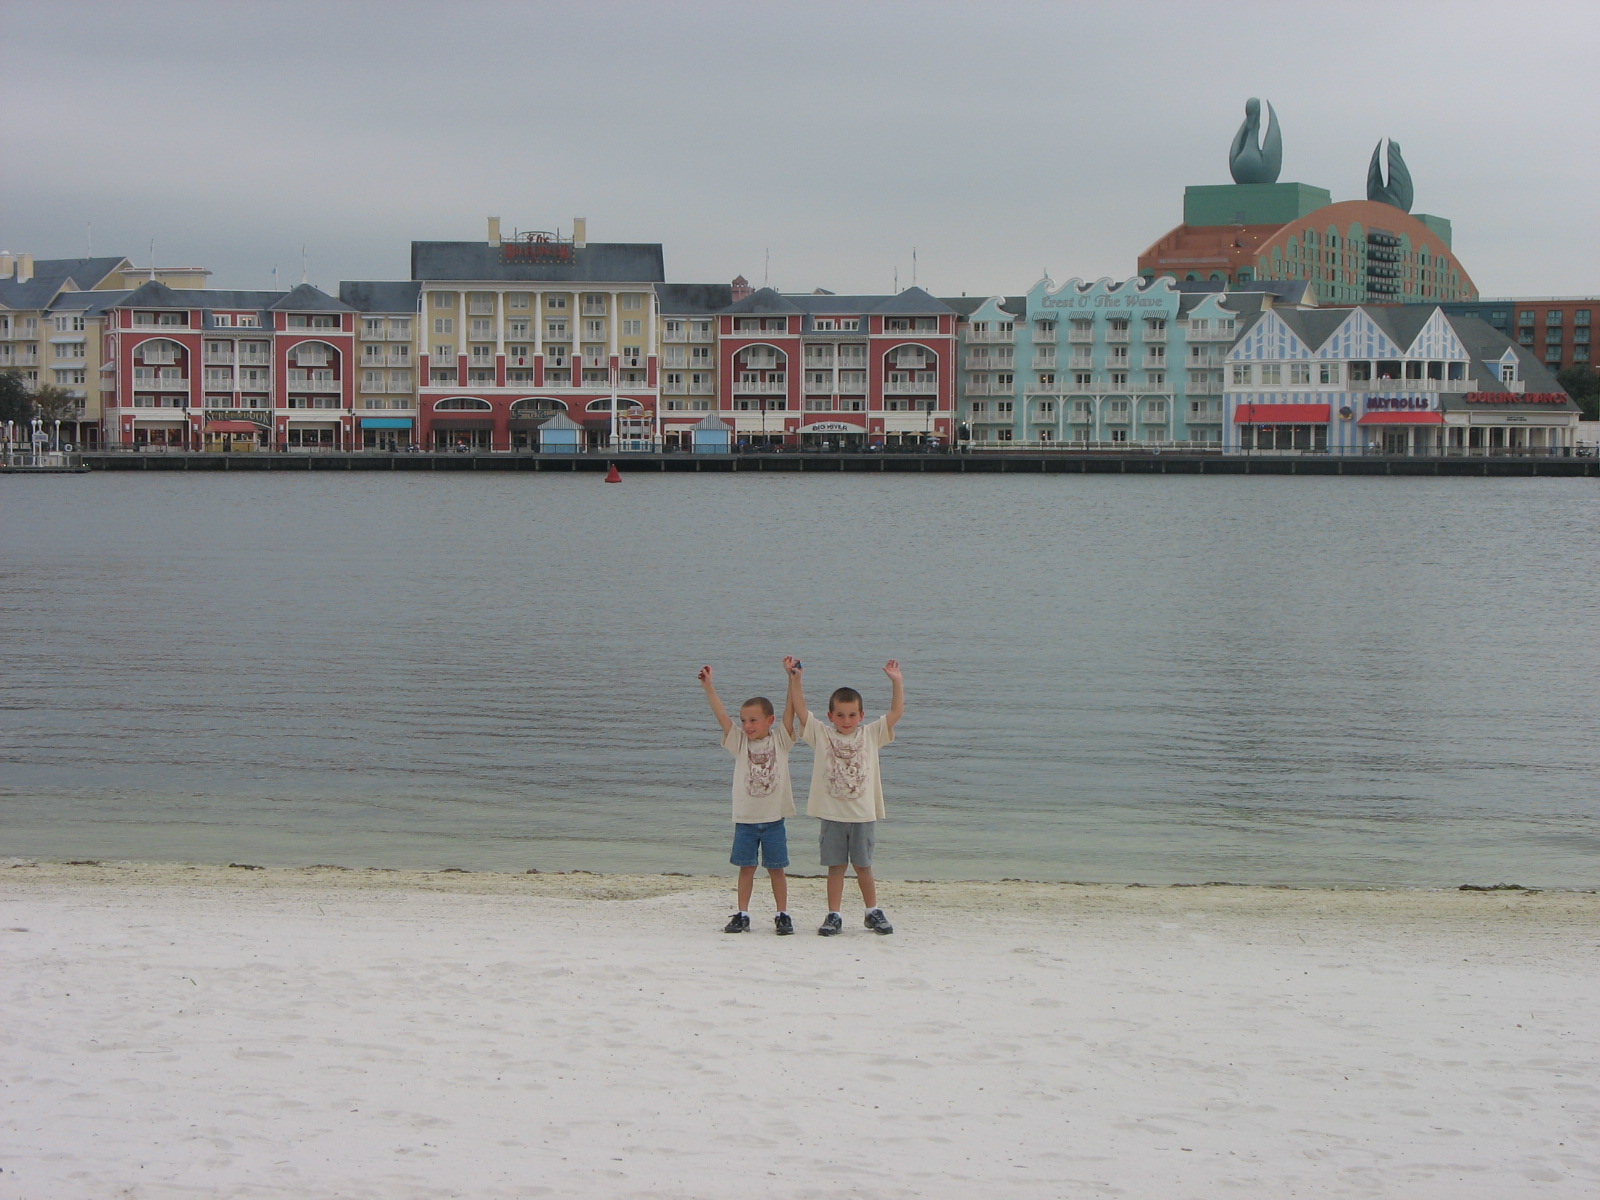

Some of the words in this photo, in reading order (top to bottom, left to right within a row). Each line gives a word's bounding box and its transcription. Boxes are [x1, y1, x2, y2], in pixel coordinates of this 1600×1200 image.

[527, 234, 550, 244] The
[1041, 296, 1075, 308] Crest
[1094, 295, 1121, 307] The
[1125, 295, 1163, 307] Wave
